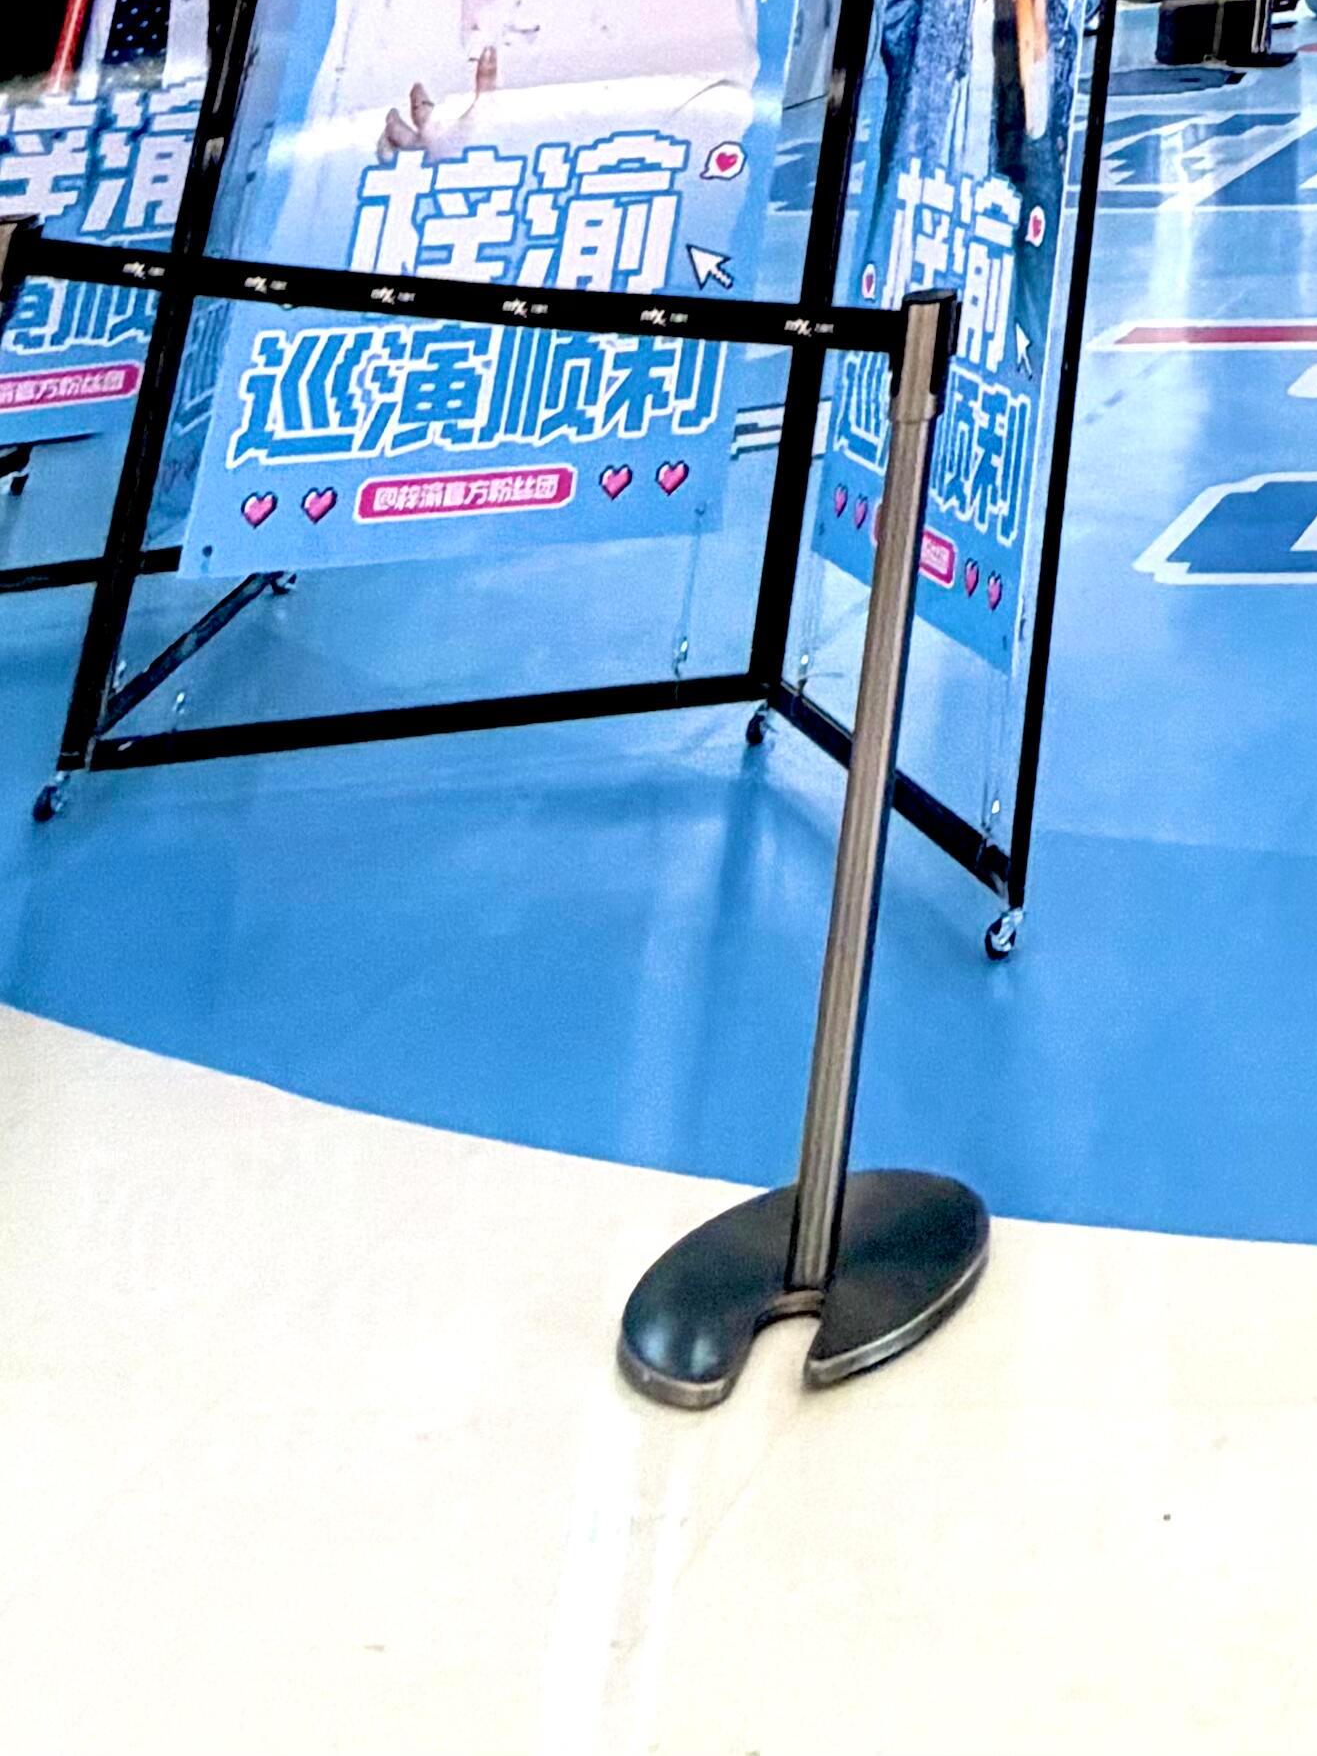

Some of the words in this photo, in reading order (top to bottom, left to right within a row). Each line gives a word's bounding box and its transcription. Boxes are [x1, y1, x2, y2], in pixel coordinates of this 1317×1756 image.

[349, 130, 690, 295] 梓渝
[882, 157, 1024, 373] 梓渝
[226, 322, 728, 470] 巡演顺利
[833, 349, 1032, 548] 巡顺利
